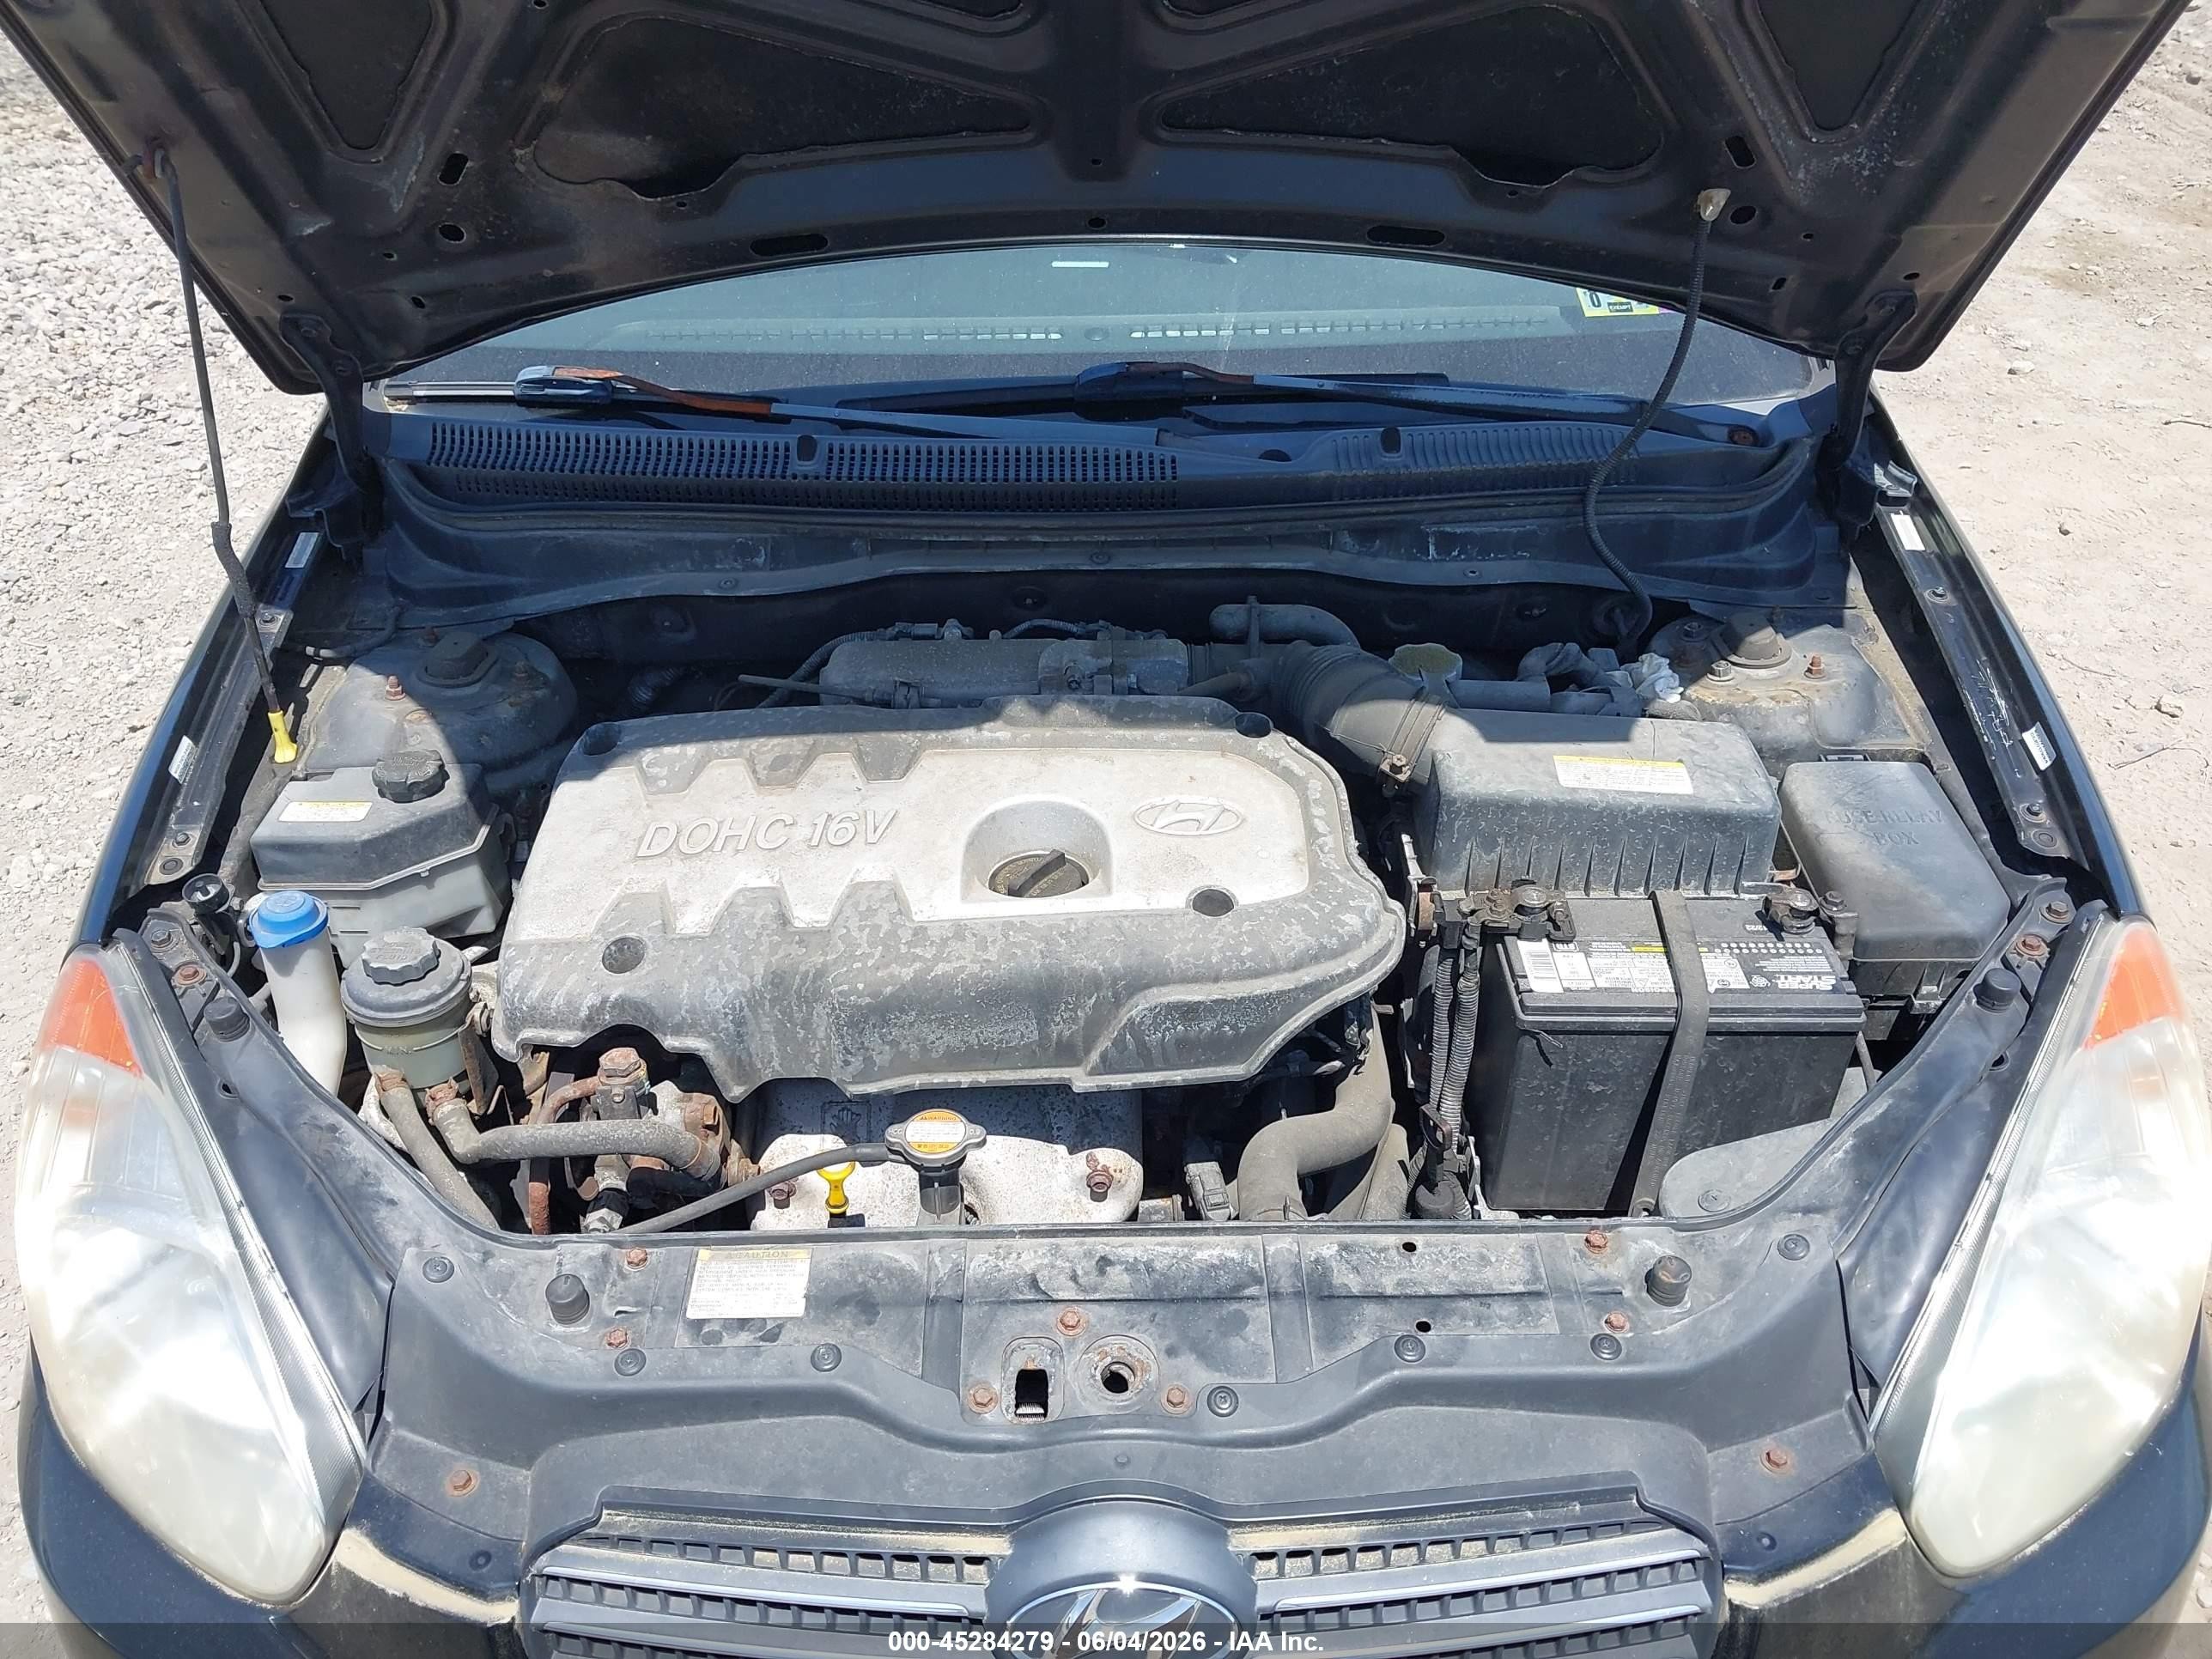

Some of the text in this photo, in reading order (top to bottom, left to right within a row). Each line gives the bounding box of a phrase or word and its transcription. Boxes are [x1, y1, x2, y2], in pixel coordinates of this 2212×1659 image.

[635, 810, 898, 858] DOHC 16V
[1873, 831, 1919, 845] BOX
[1776, 975, 1836, 985] START
